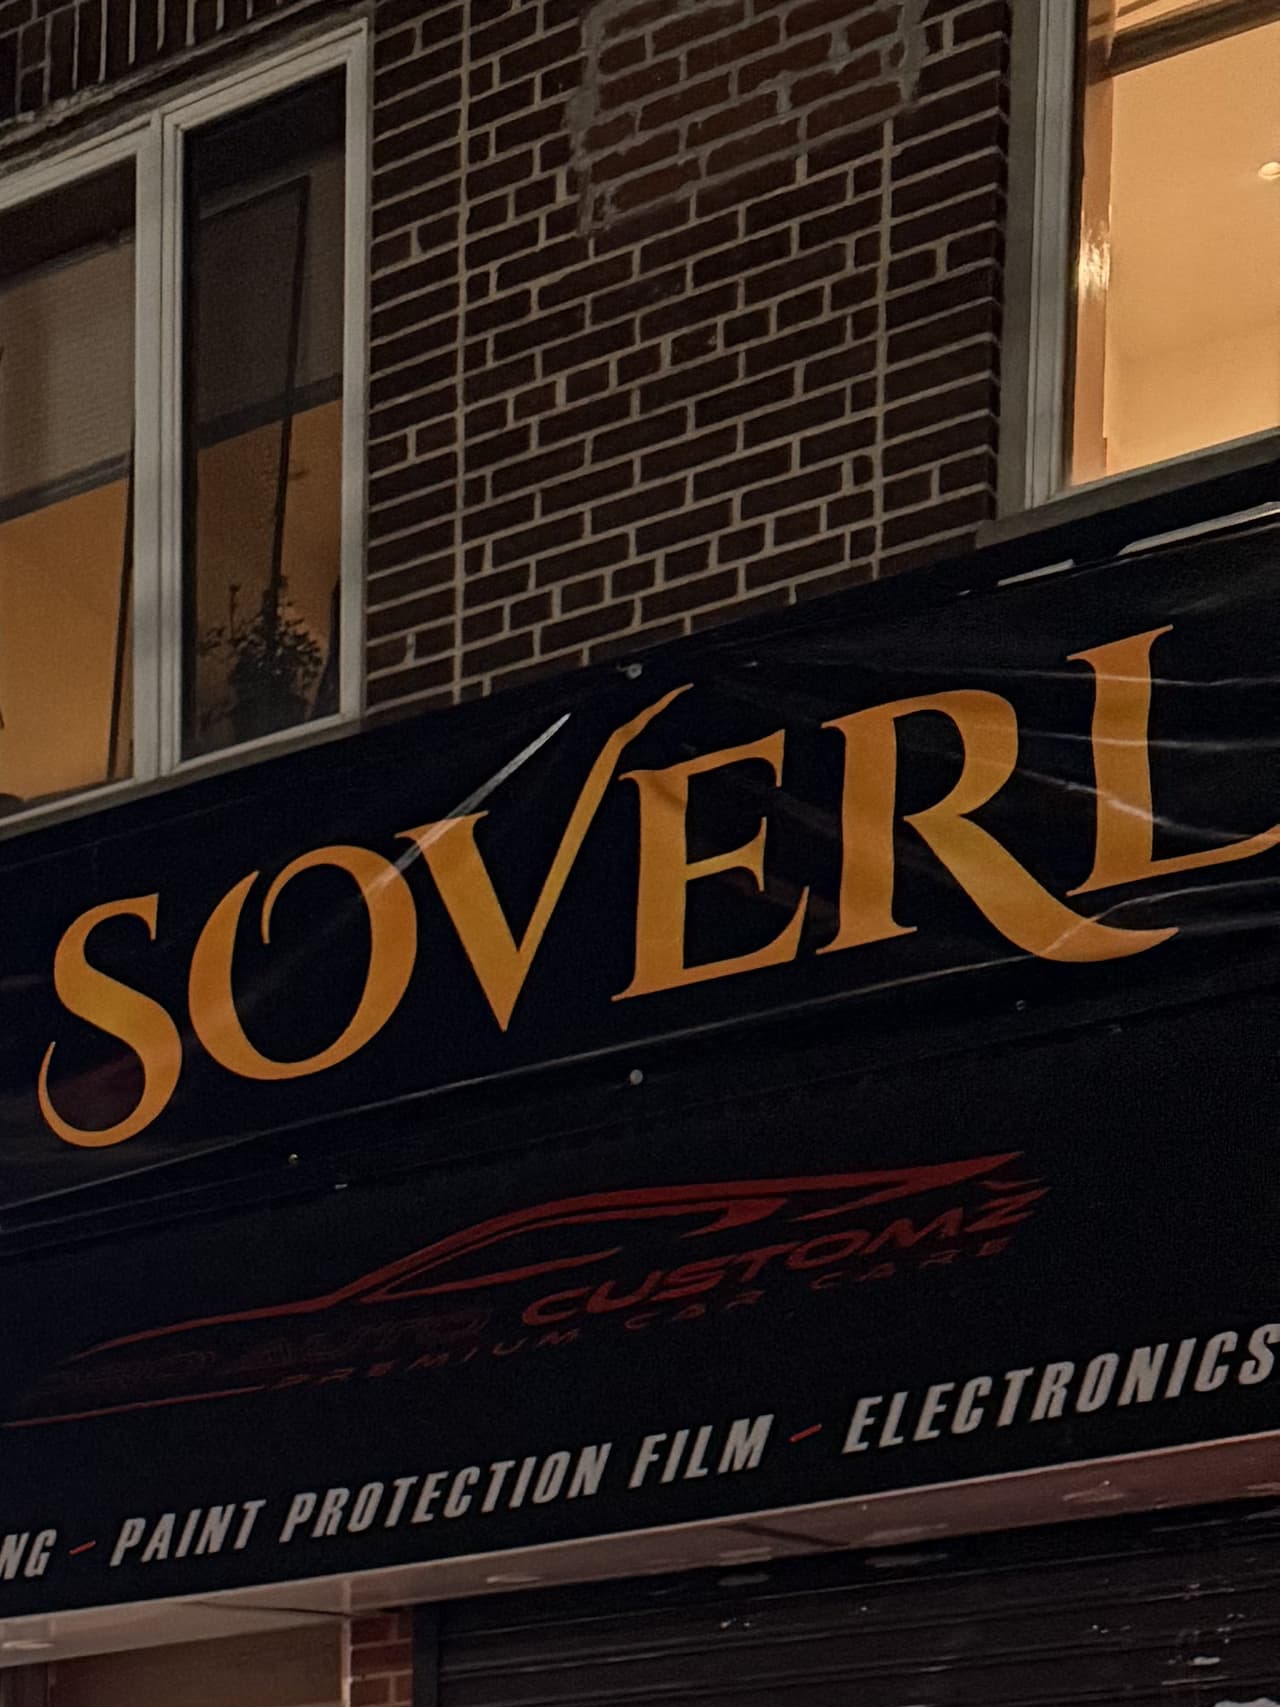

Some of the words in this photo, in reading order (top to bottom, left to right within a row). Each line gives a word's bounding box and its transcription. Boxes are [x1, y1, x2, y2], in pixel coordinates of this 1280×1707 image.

[39, 624, 1280, 1148] SOVERL
[521, 1179, 1051, 1326] CUSTOMZ
[110, 1500, 265, 1568] PAINT
[279, 1440, 615, 1545] PROTECTION
[628, 1414, 775, 1493] FILM
[841, 1323, 1280, 1455] ELECTRONICS
